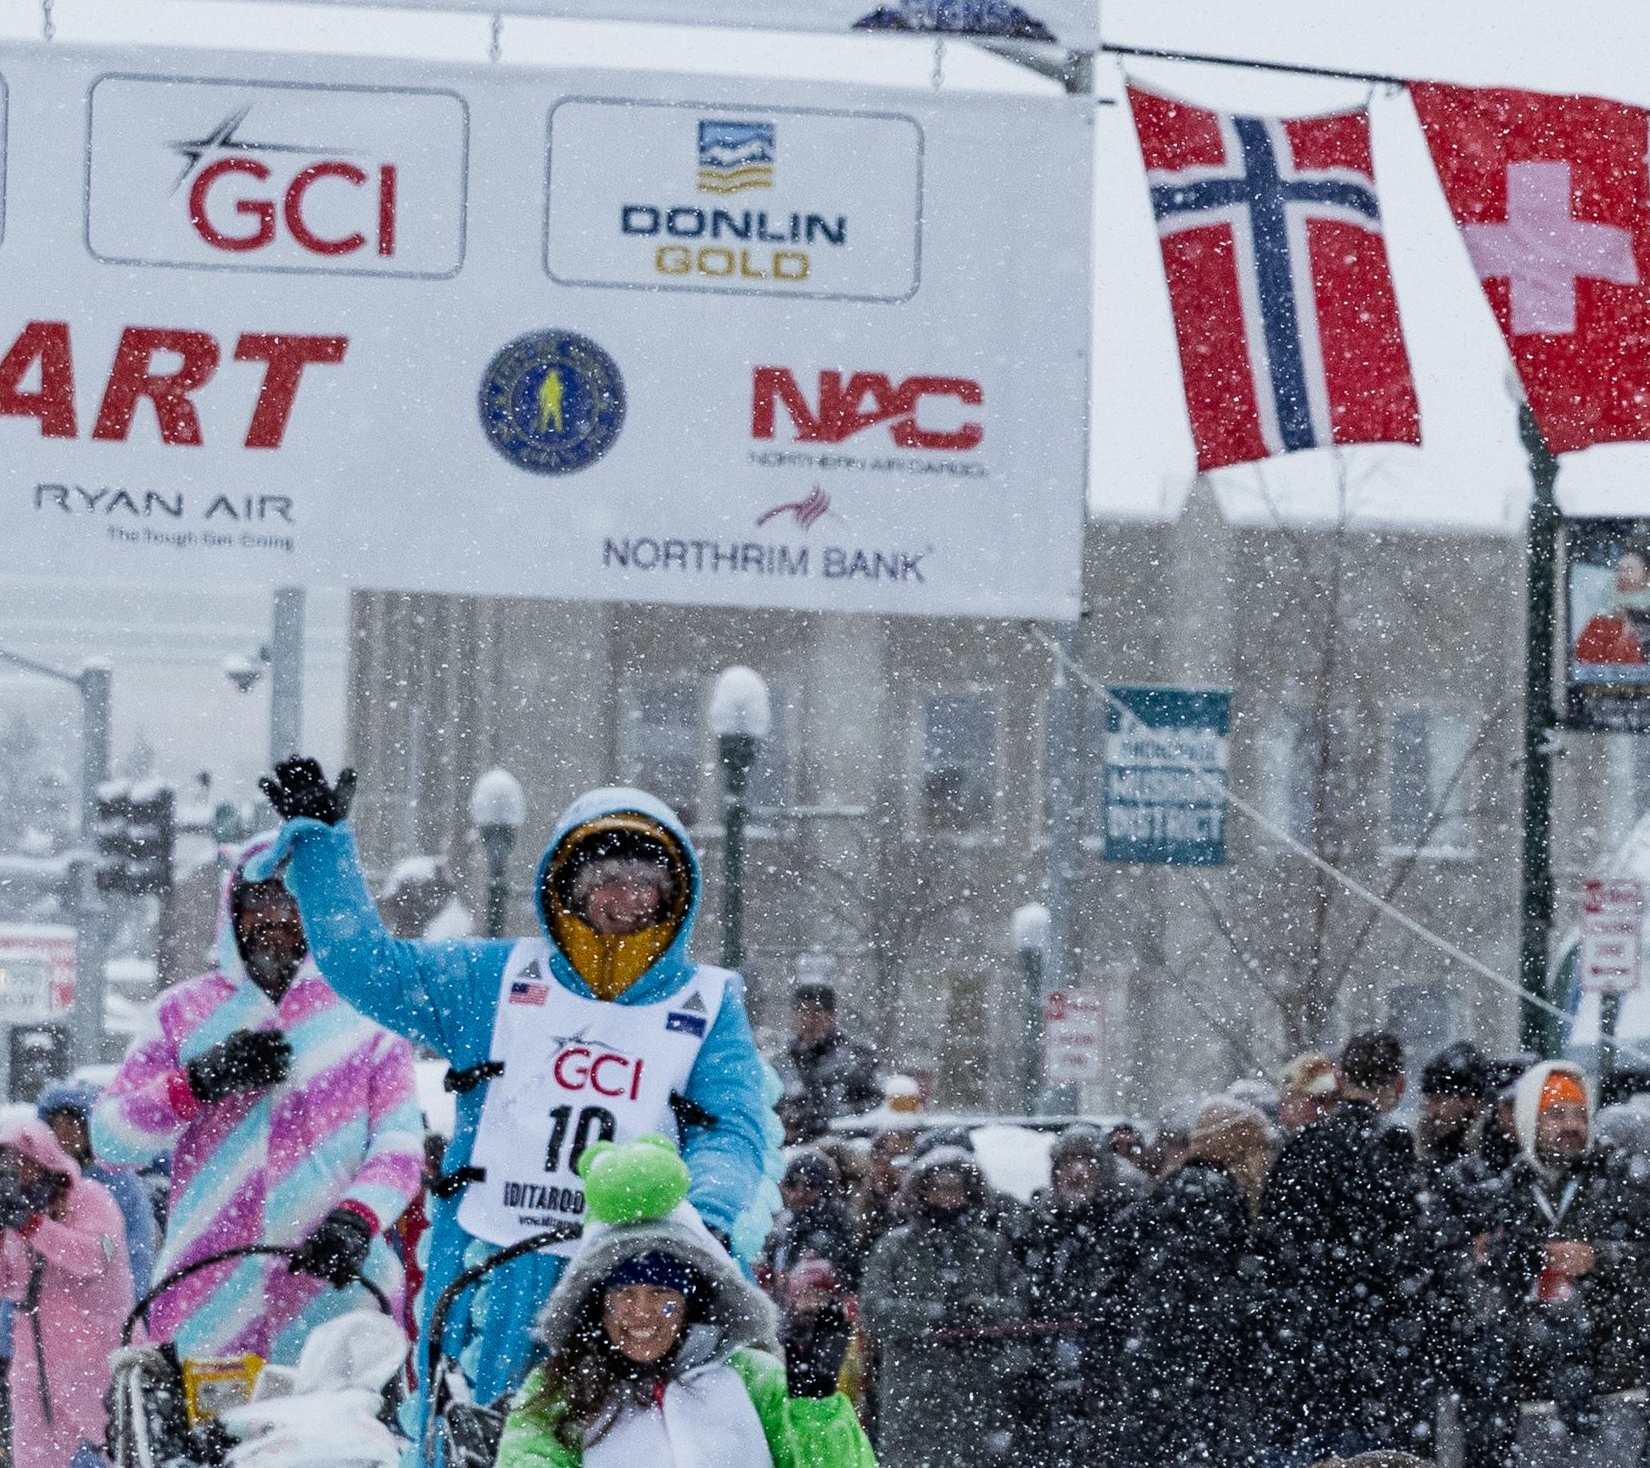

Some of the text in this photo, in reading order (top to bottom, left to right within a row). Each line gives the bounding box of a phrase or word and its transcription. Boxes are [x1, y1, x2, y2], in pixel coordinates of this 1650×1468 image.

[186, 156, 398, 257] GCI
[620, 204, 850, 247] DONLIN
[652, 244, 812, 283] GOLD
[751, 365, 985, 452] NAC
[34, 482, 296, 525] RYAN AIR
[601, 537, 928, 583] NORTHRIM BANK
[553, 1046, 644, 1101] GCI
[544, 1103, 617, 1178] 10
[503, 1181, 585, 1215] IDITAROD
